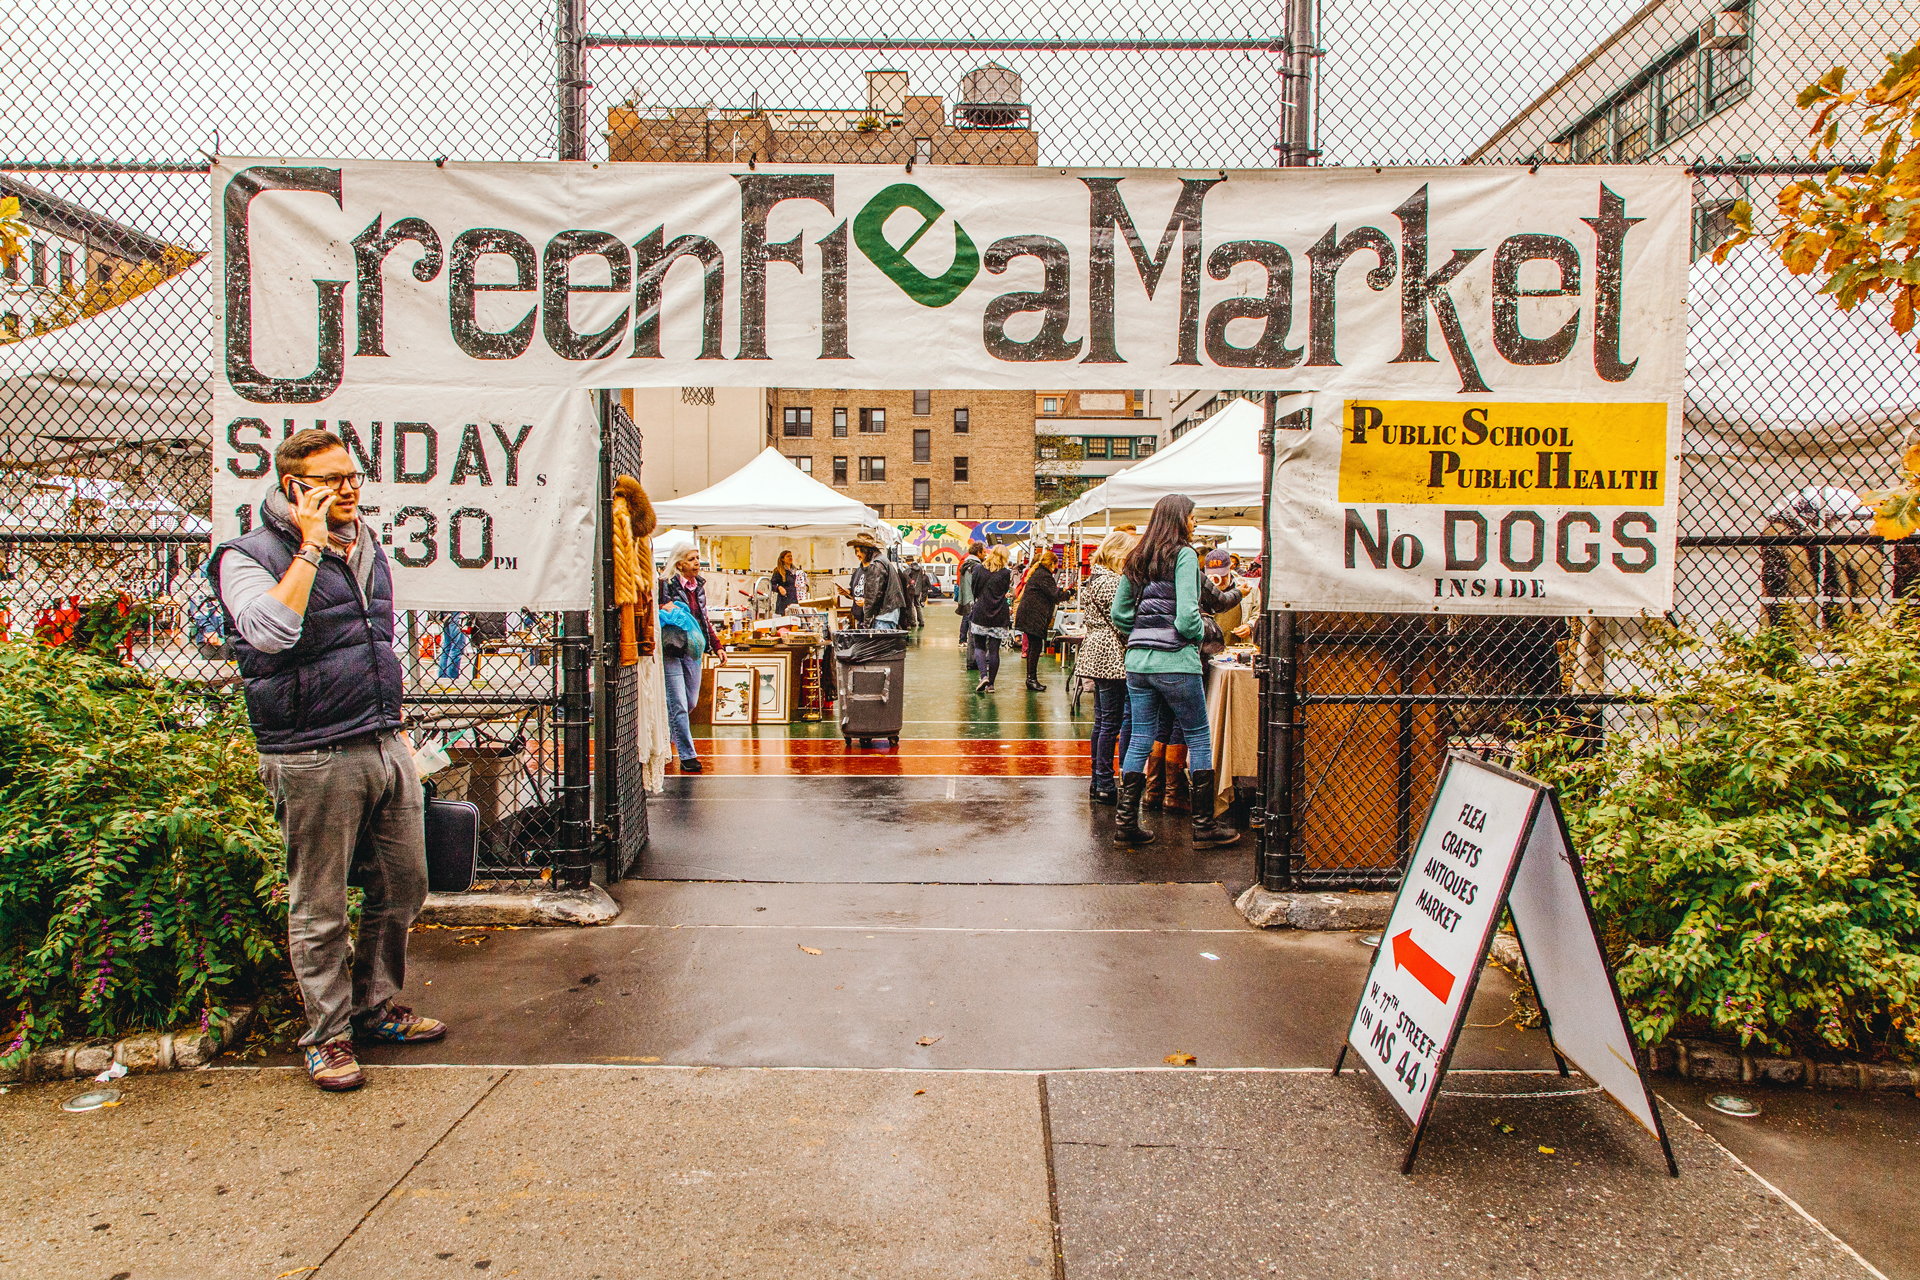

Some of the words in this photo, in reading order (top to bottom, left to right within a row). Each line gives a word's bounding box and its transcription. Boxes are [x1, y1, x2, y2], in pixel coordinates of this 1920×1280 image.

[1444, 509, 1658, 574] DOGS
[1434, 577, 1546, 599] INSIDE
[1457, 803, 1487, 833] FLEA
[1441, 830, 1483, 868] CRAFTS
[1423, 856, 1479, 906] ANTIQUES
[1415, 888, 1462, 933] MARKET
[1370, 1019, 1396, 1065] MS
[1396, 1011, 1436, 1058] STREET
